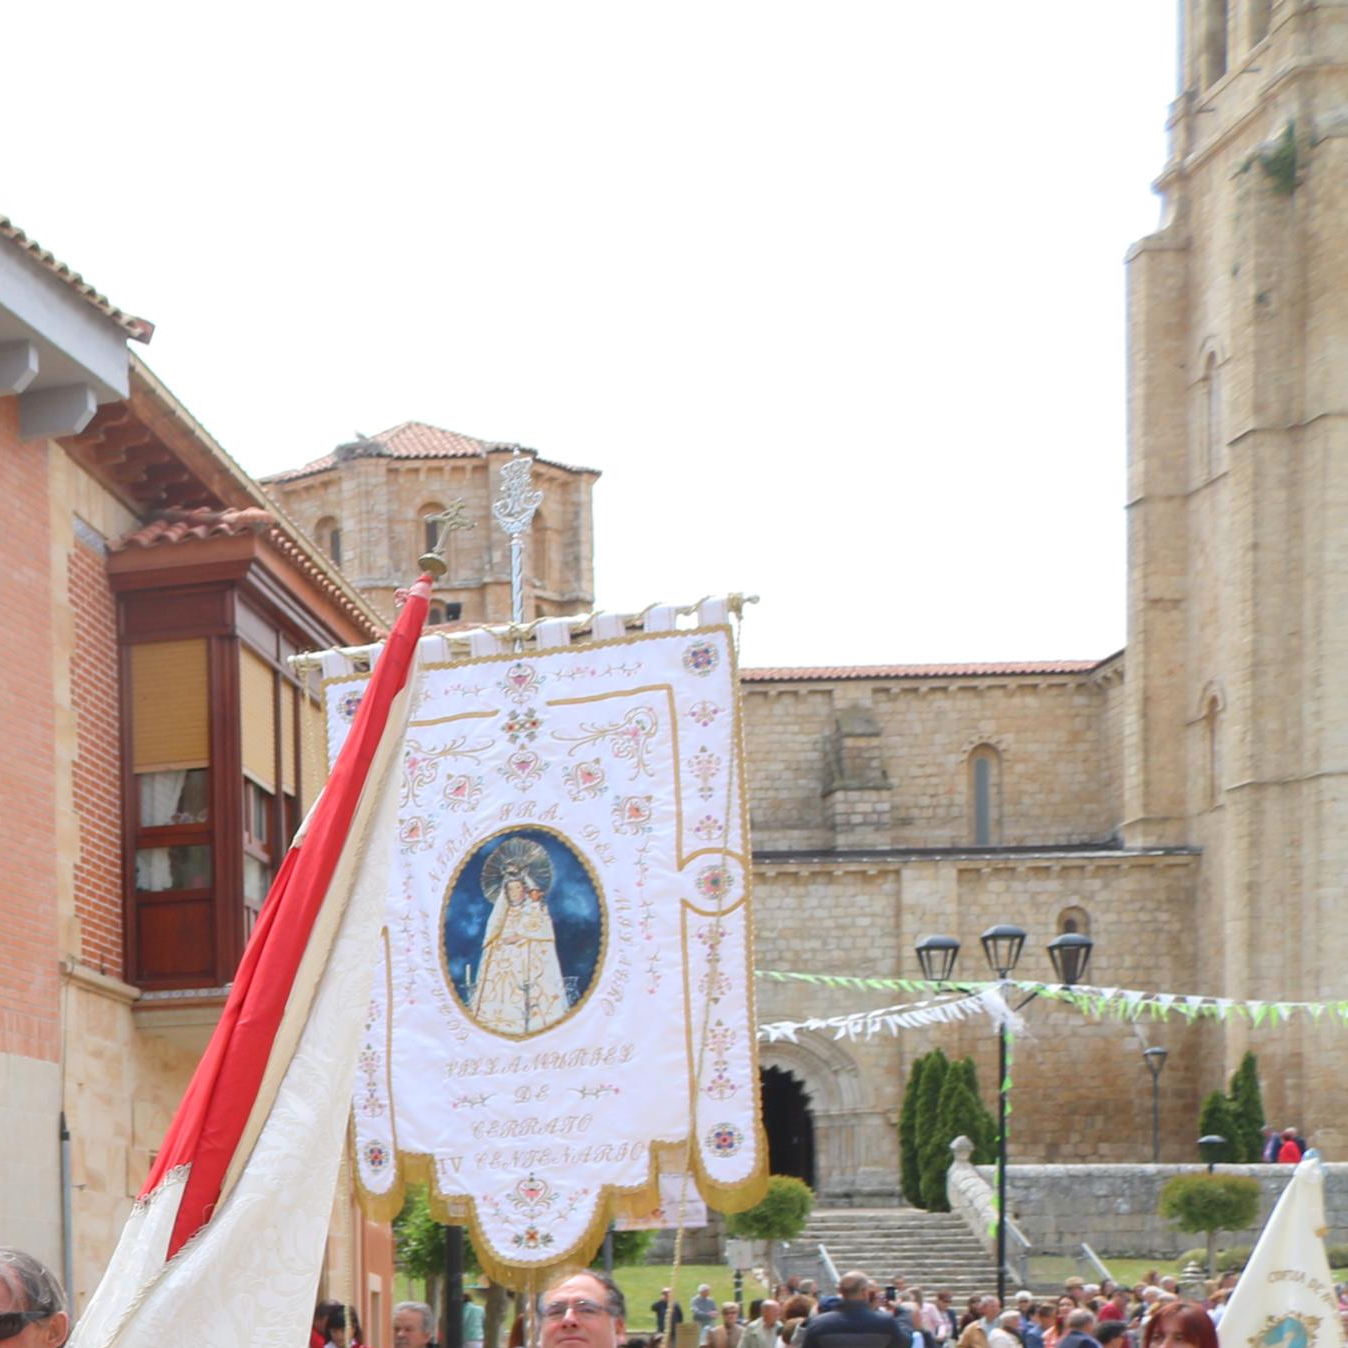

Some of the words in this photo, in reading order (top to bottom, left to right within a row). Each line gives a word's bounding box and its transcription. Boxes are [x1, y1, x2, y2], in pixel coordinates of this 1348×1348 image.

[444, 1043, 635, 1078] VILLAMURIEL
[513, 1084, 550, 1104] DE
[472, 1113, 593, 1139] CERRATO
[438, 1156, 464, 1175] IV
[474, 1141, 646, 1170] CENTENARIO
